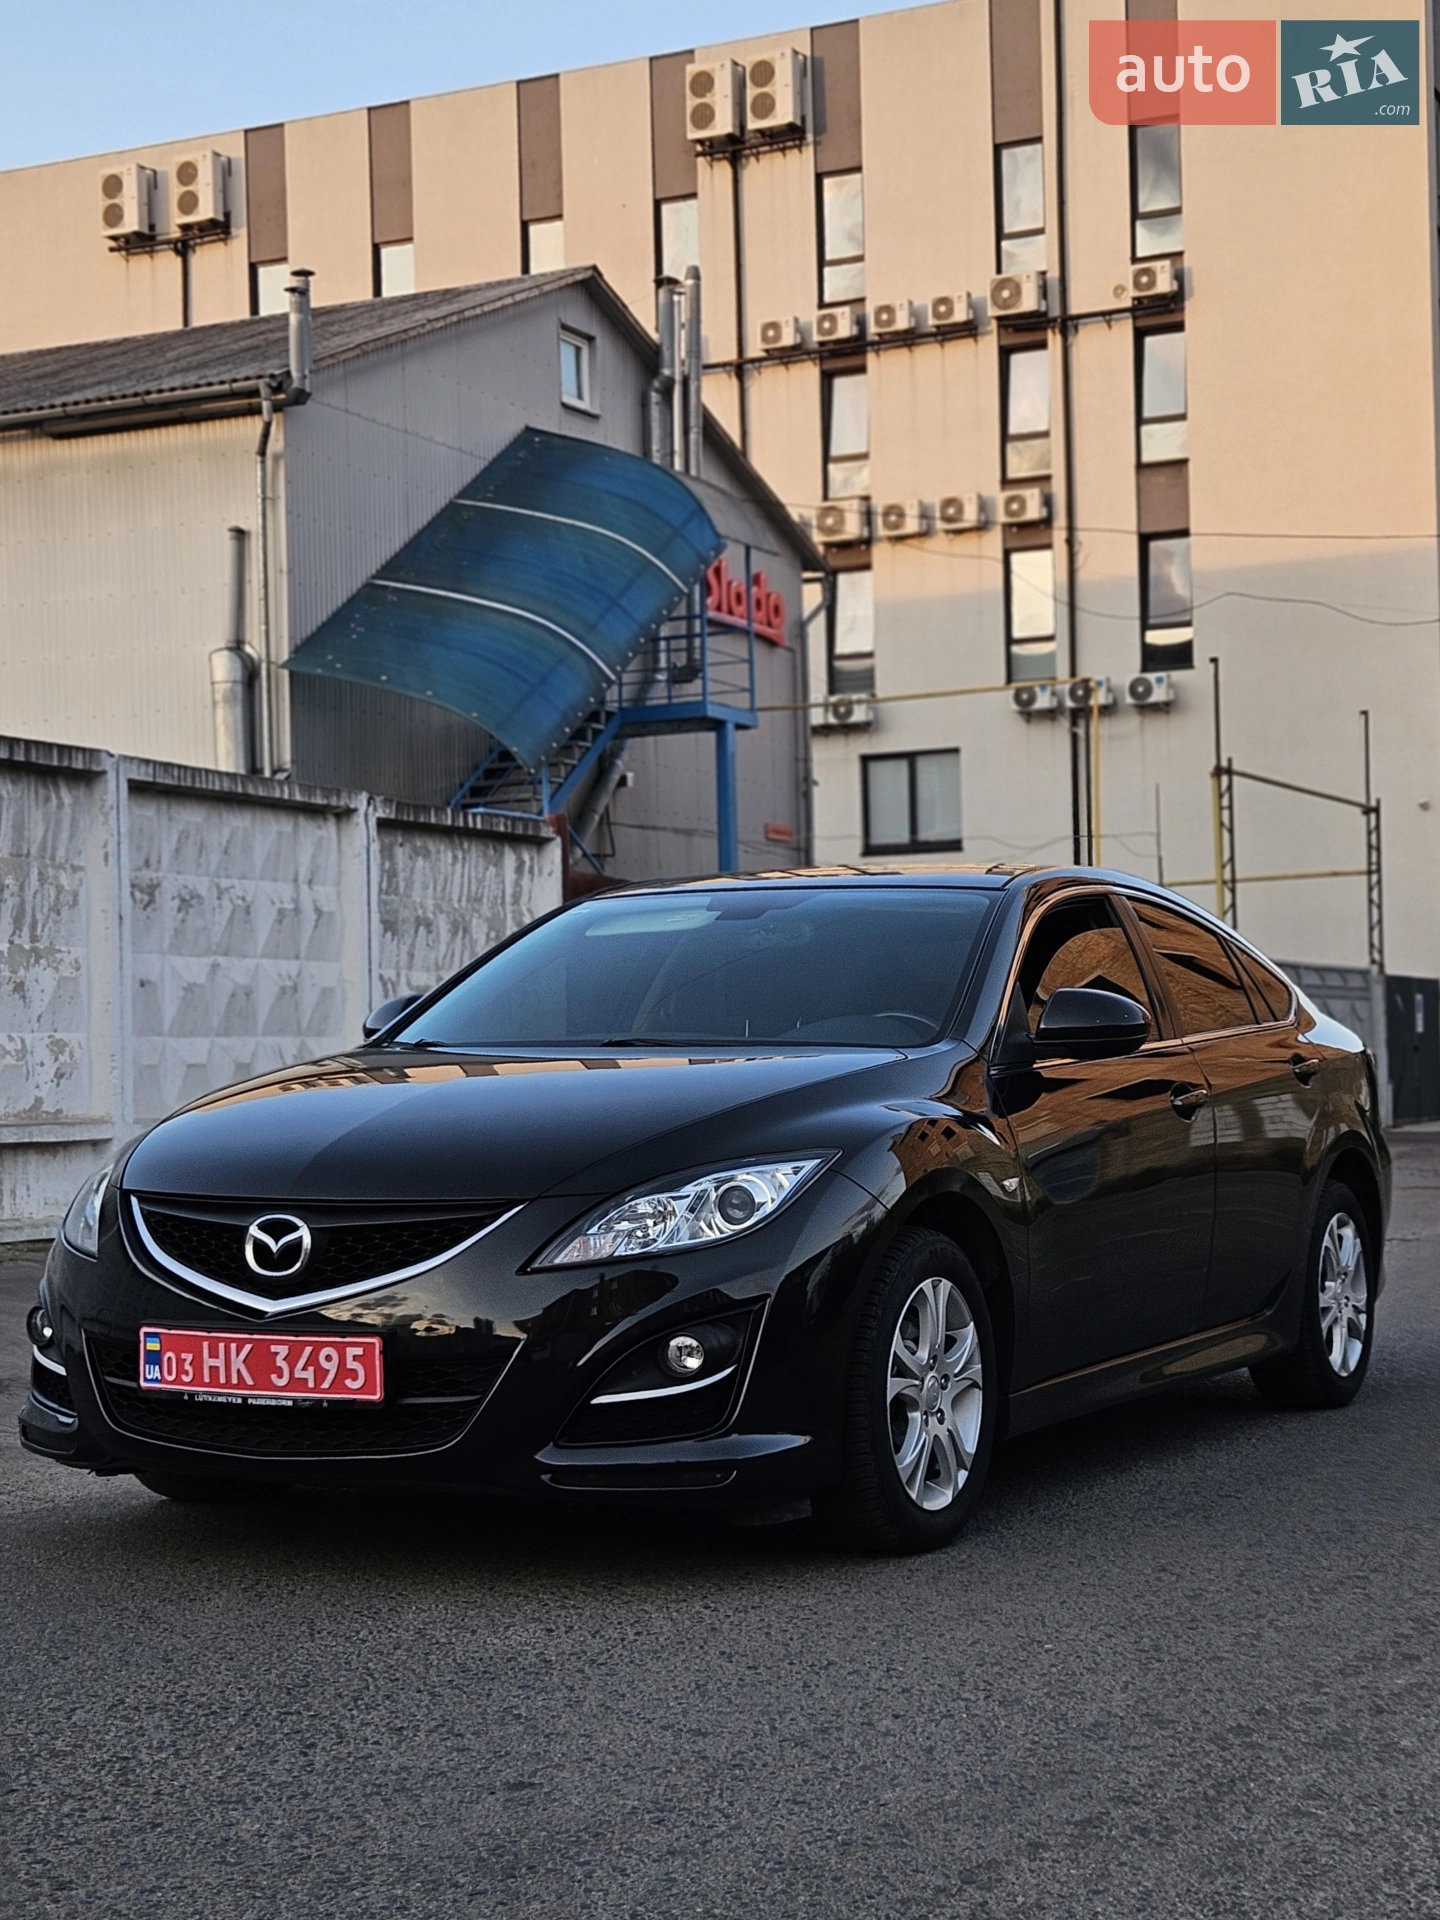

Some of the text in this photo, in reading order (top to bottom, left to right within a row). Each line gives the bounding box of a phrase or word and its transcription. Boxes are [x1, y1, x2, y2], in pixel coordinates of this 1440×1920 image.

[145, 1364, 161, 1380] UA
[163, 1341, 366, 1390] 03 HK 3495
